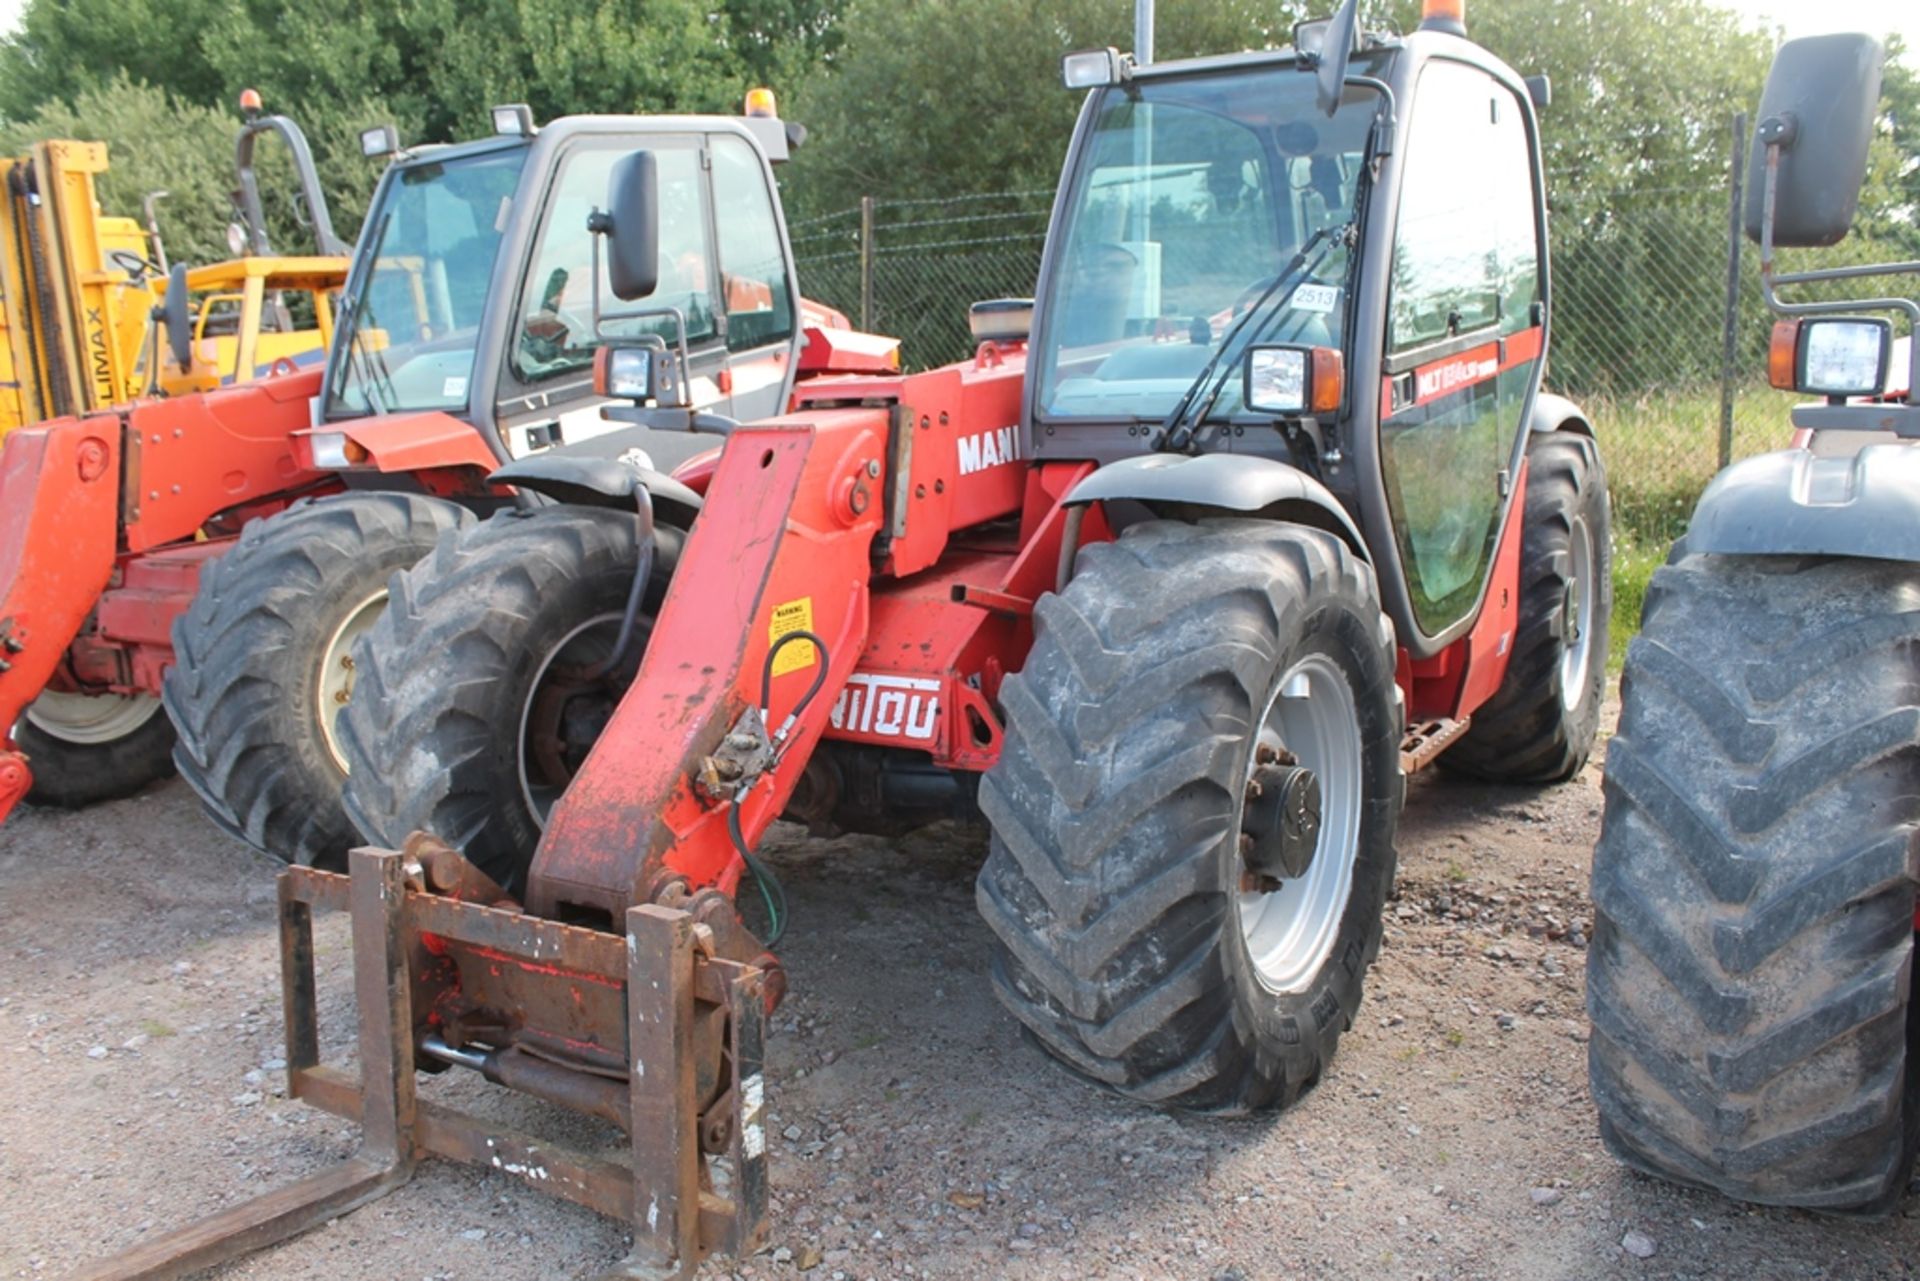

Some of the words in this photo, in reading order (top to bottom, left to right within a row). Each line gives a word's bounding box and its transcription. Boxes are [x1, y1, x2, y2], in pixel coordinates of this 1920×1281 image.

[1295, 289, 1334, 305] 2513
[87, 307, 113, 402] LIMAX
[1418, 368, 1442, 398] MLT
[957, 425, 1020, 475] MANI
